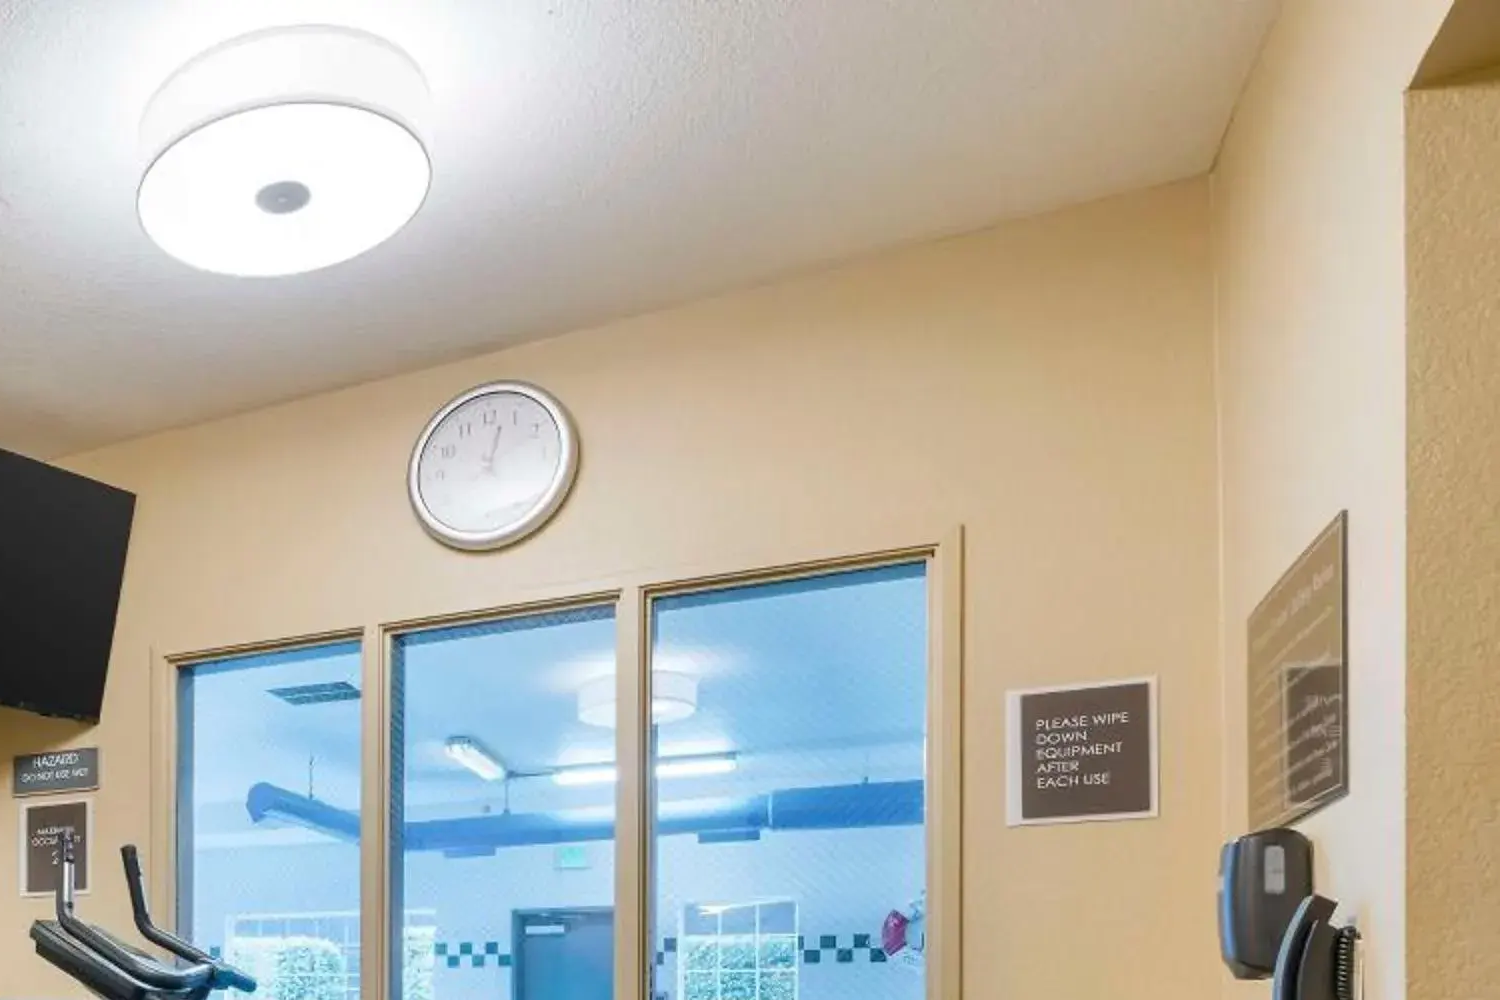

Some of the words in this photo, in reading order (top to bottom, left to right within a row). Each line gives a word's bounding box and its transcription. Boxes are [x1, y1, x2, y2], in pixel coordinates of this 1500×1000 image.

[482, 409, 497, 425] 12
[512, 410, 518, 426] 1
[458, 422, 472, 439] 11
[1035, 715, 1088, 731] PLEASE
[1091, 711, 1129, 725] WIPE
[1035, 730, 1088, 745] DOWN
[1035, 741, 1123, 760] EQUIPMENT
[1036, 761, 1080, 774] AFTER
[1036, 775, 1079, 789] EACH
[1083, 772, 1111, 785] USE
